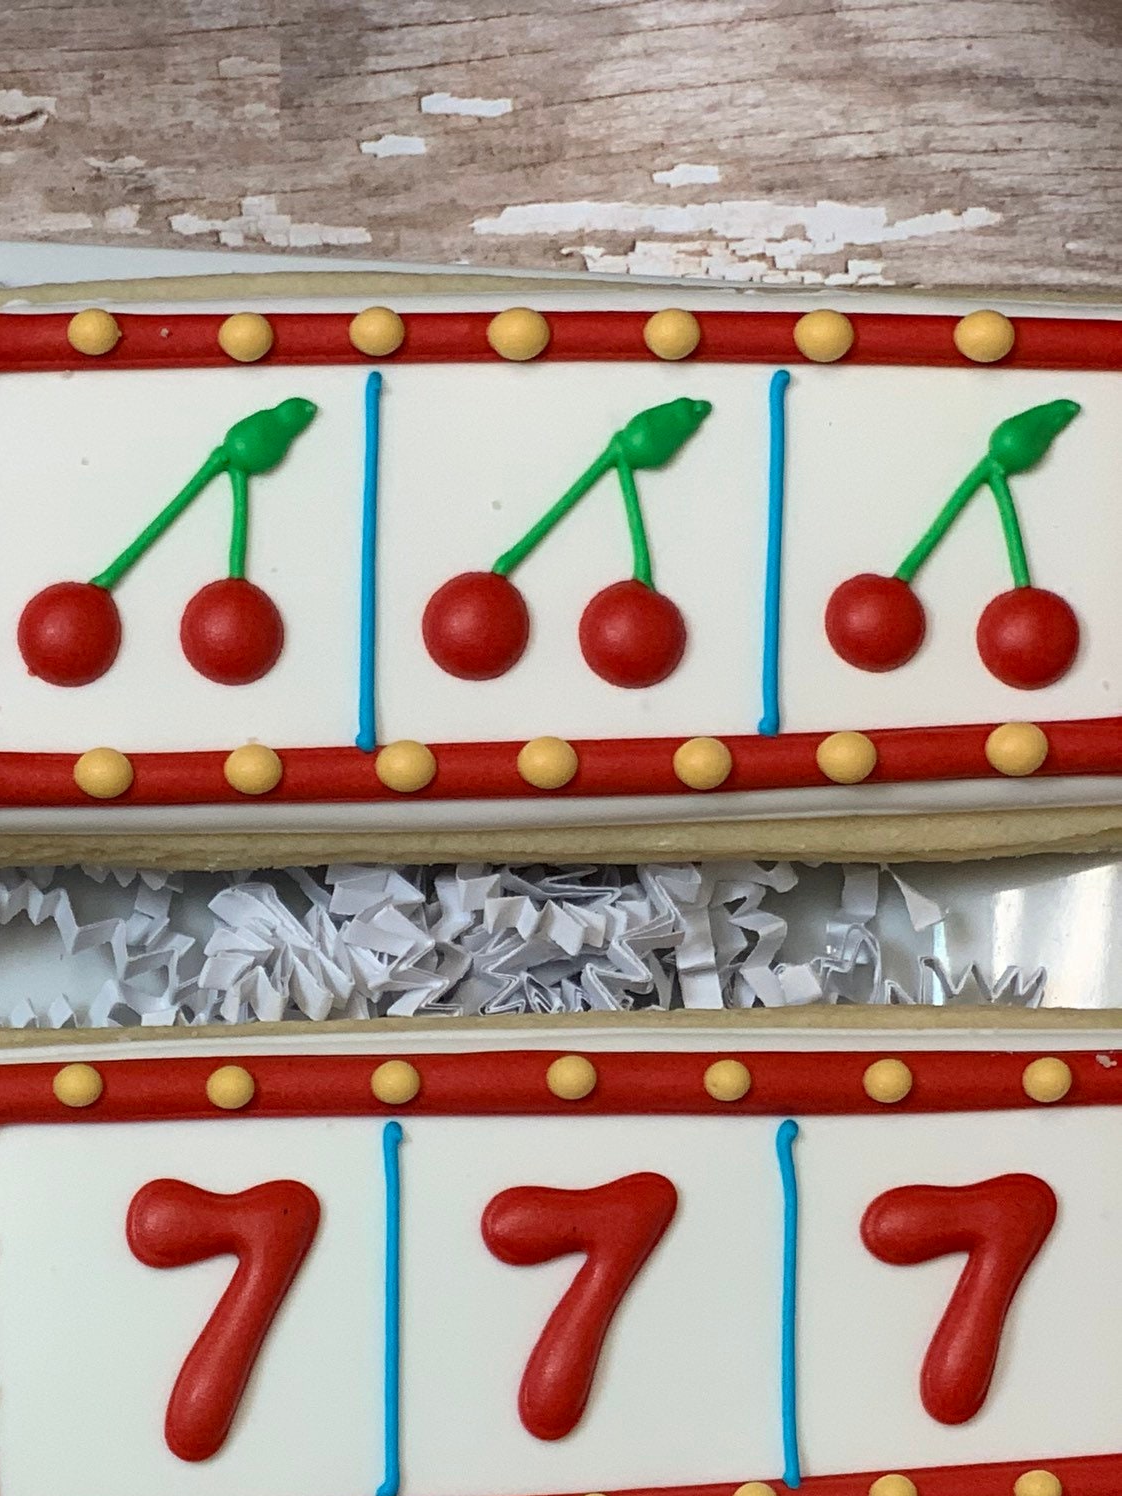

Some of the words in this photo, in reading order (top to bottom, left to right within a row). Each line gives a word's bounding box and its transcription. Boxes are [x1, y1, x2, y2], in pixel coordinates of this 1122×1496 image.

[125, 1177, 322, 1463] 7
[480, 1171, 679, 1442] 7
[859, 1172, 1058, 1426] 7
